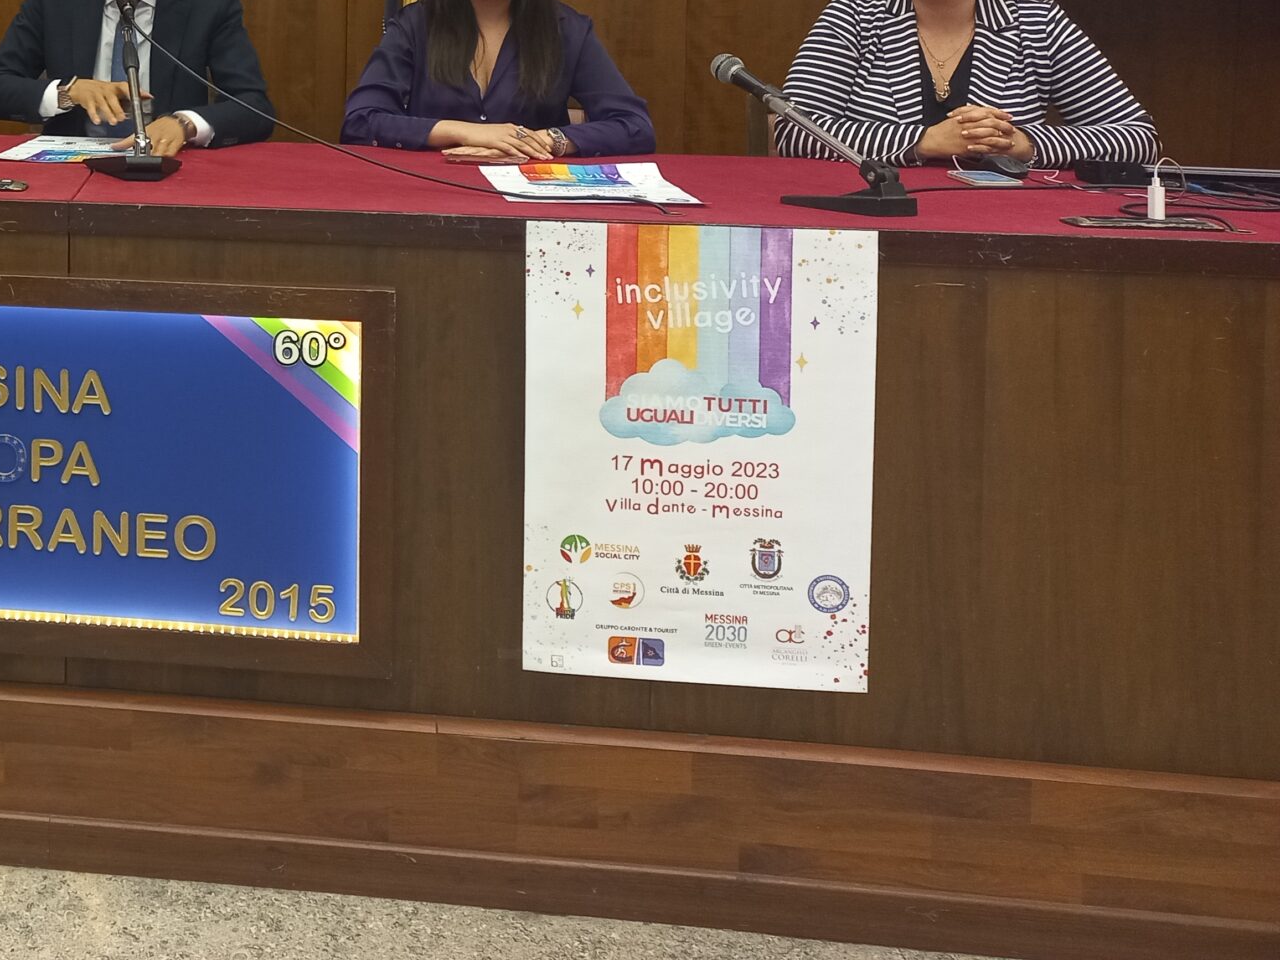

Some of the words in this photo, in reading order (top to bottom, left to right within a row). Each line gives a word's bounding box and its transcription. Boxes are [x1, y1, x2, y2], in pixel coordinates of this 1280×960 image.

[615, 272, 782, 305] inclusivity
[646, 302, 756, 333] village
[627, 393, 702, 409] SIAMO
[703, 396, 768, 415] TUTTI
[626, 407, 694, 425] UGUALI
[696, 413, 767, 429] DIVERSI
[611, 455, 633, 471] 17
[731, 461, 780, 479] 2023
[631, 478, 684, 496] 10:00
[704, 482, 758, 500] 20:00
[605, 497, 641, 512] Villa
[594, 543, 640, 553] MESSINA
[594, 552, 621, 560] SOCIAL
[219, 578, 337, 624] 2015
[660, 586, 680, 595] Città
[682, 587, 690, 595] di
[692, 588, 724, 597] Messina
[704, 613, 748, 625] MESSINA
[704, 625, 748, 643] 2030
